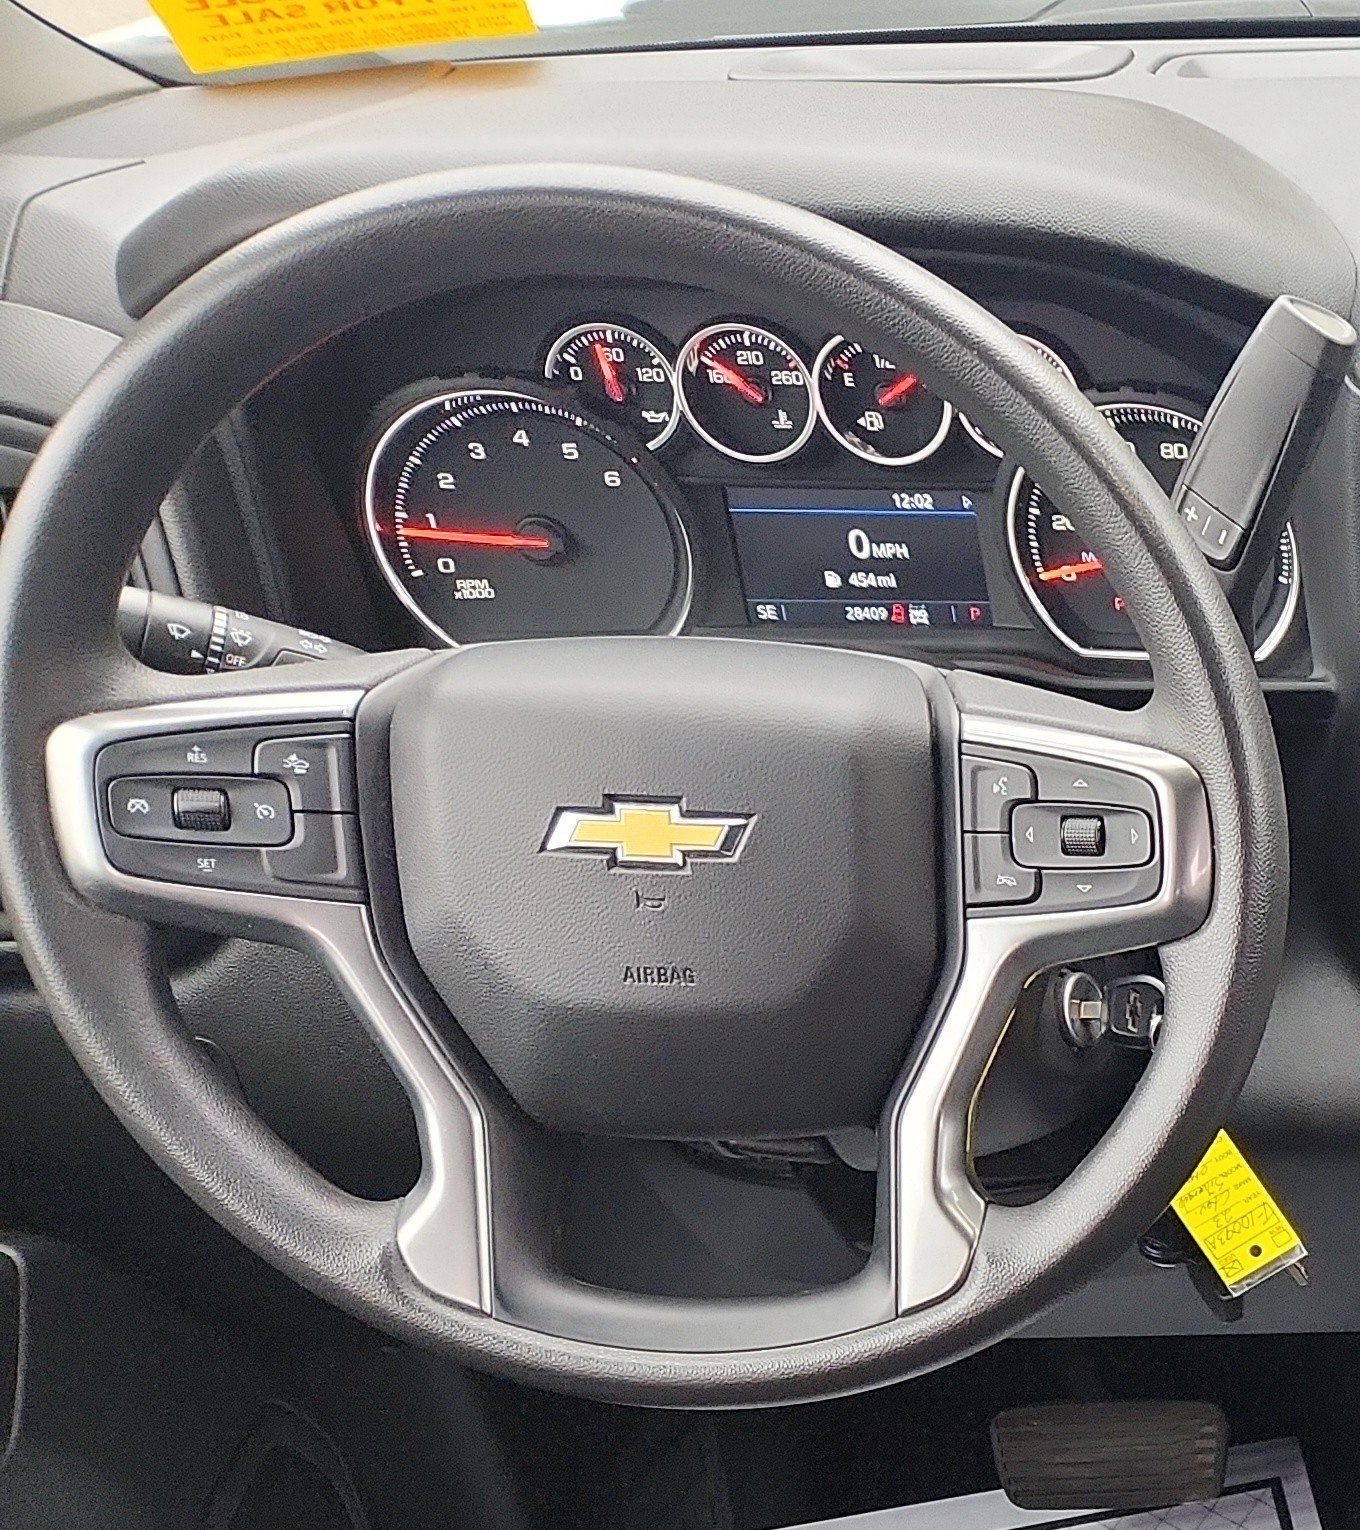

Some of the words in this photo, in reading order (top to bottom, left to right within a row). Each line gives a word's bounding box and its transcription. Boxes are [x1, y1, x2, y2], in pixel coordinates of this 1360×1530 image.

[736, 350, 764, 366] 210
[635, 367, 665, 383] 120
[771, 371, 804, 386] 260
[843, 372, 856, 388] E
[512, 429, 530, 447] 4
[467, 442, 487, 460] 3
[561, 443, 579, 460] 5
[1160, 443, 1188, 460] 80
[437, 472, 456, 490] 2
[604, 470, 621, 487] 6
[892, 493, 935, 510] 12:02
[848, 528, 871, 560] 0
[872, 543, 910, 560] MPH
[437, 557, 455, 574] 0
[455, 579, 490, 590] RPM
[454, 588, 495, 600] x1000
[756, 604, 780, 621] SE
[845, 605, 889, 622] 28409
[225, 653, 247, 667] OFF
[186, 752, 208, 764] RES
[197, 858, 217, 870] SET
[622, 965, 697, 985] AIRBAG
[1212, 1207, 1234, 1229] 23
